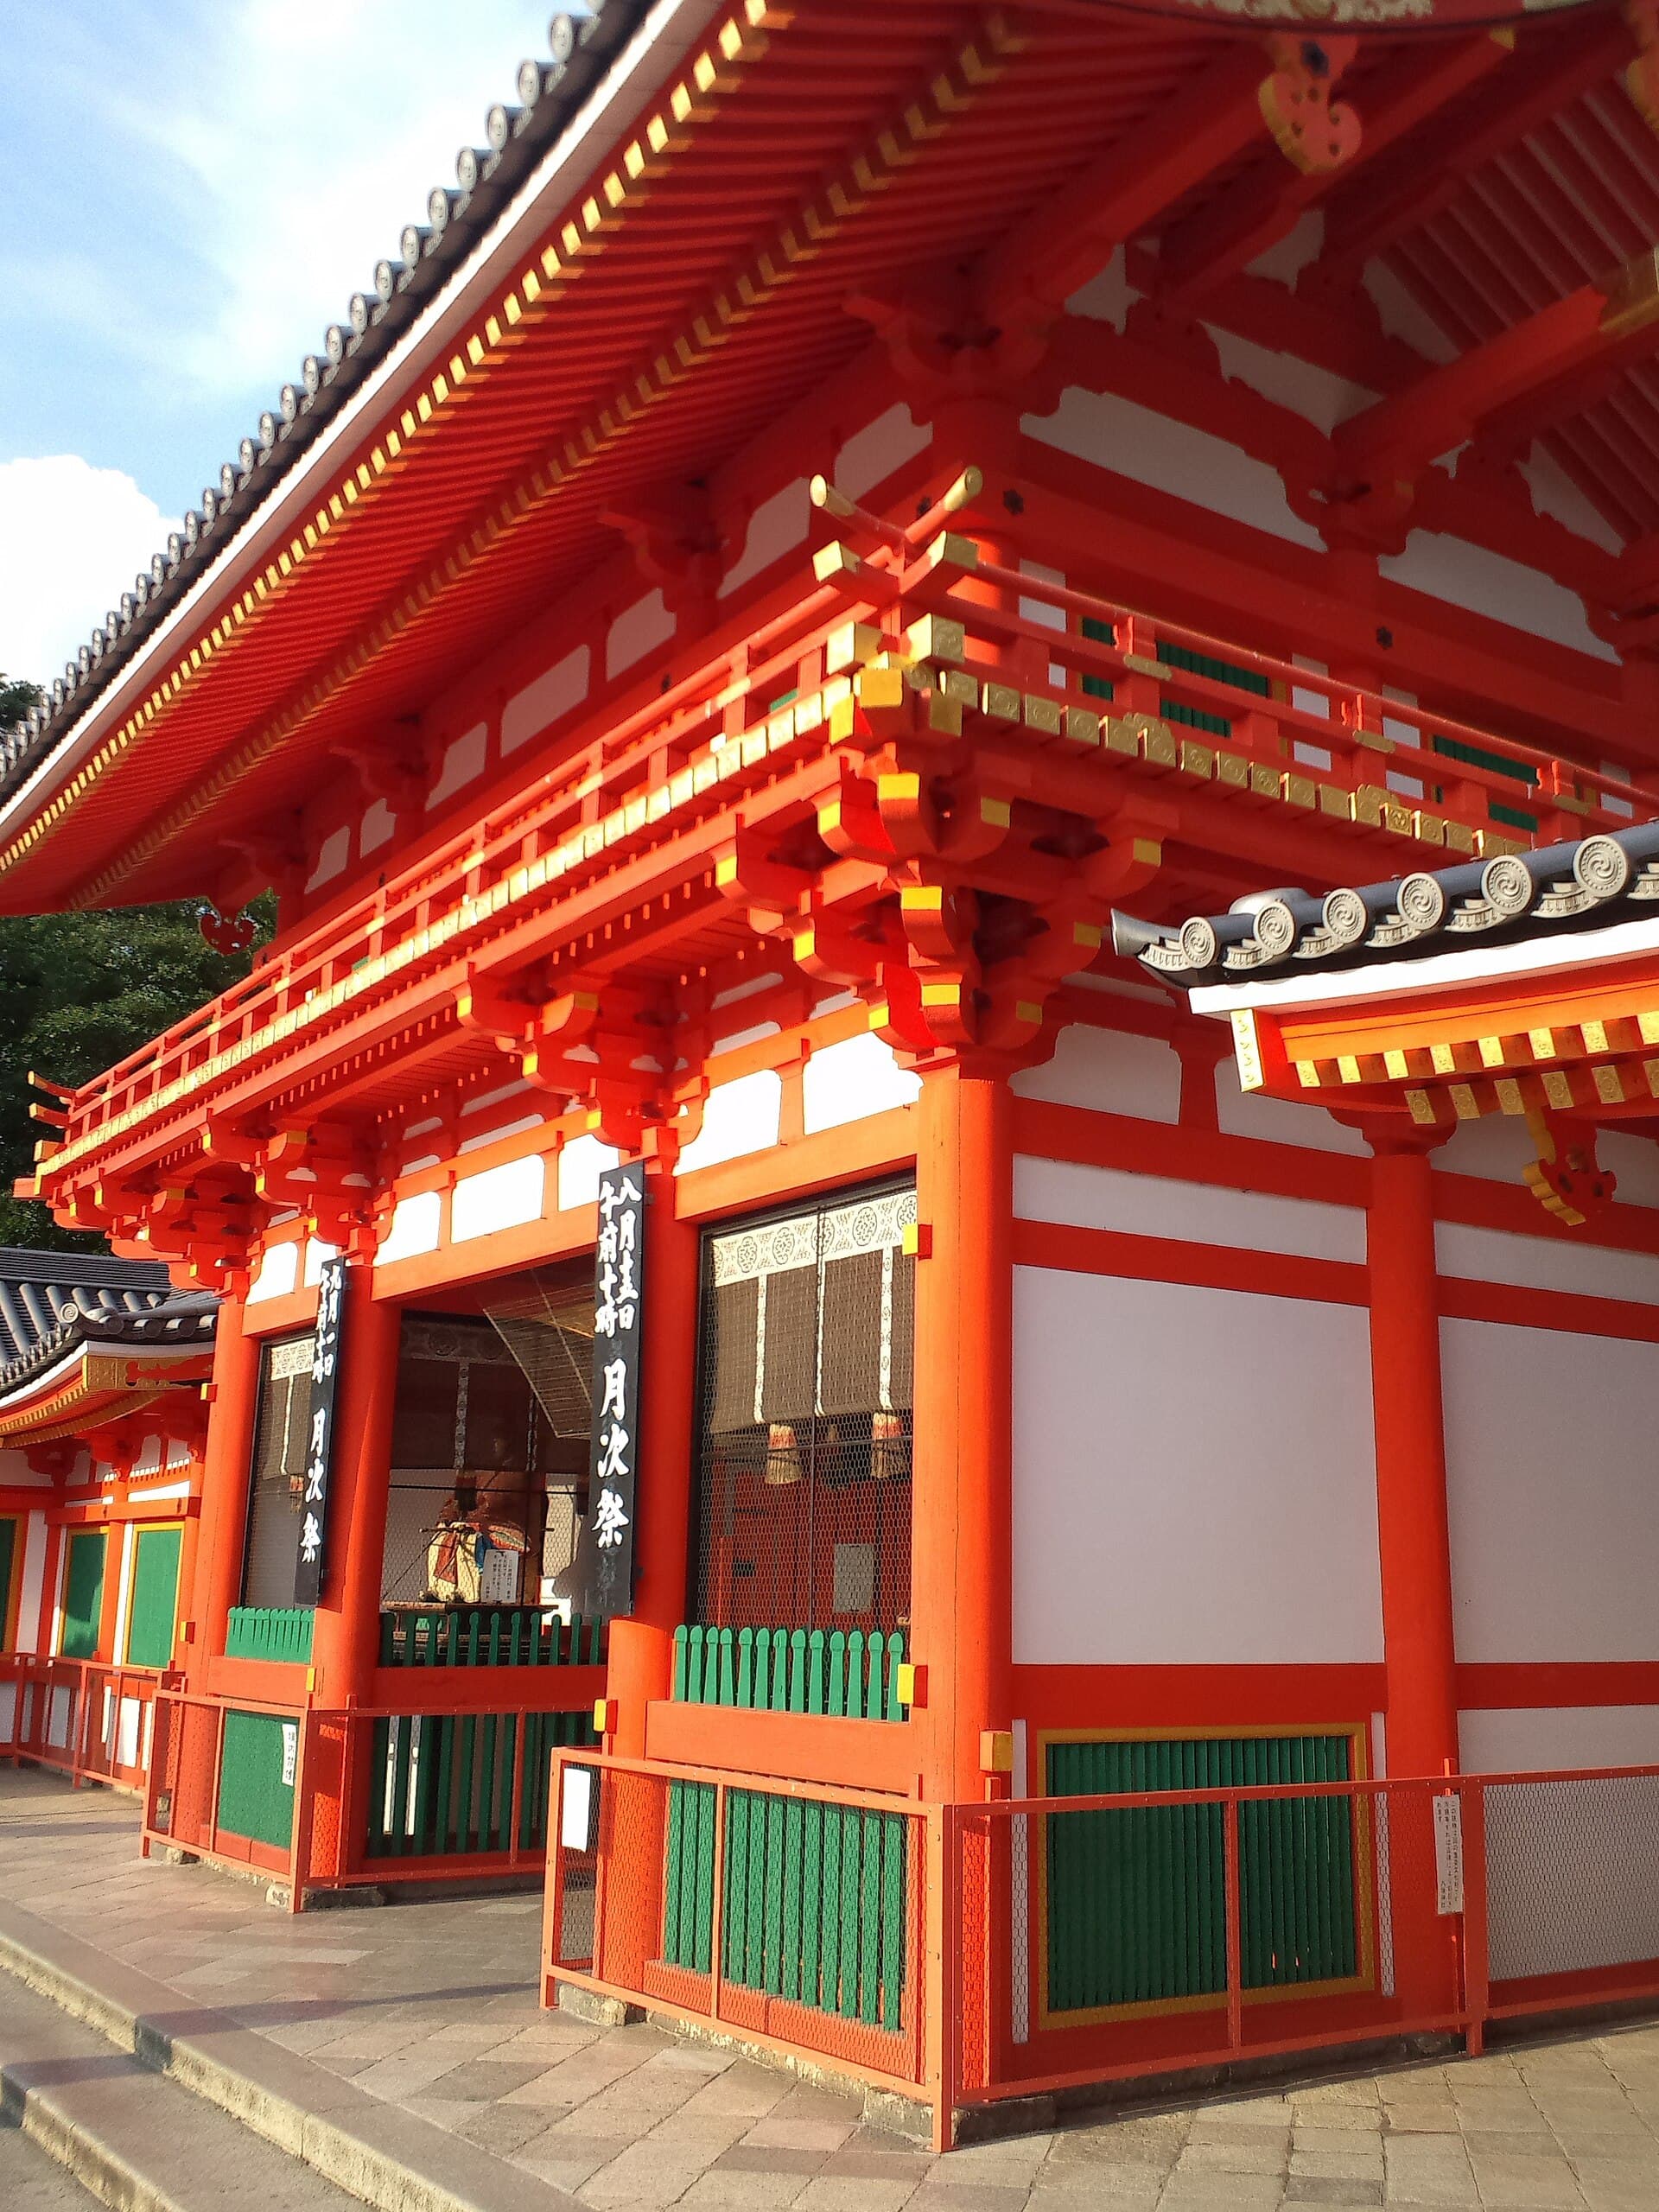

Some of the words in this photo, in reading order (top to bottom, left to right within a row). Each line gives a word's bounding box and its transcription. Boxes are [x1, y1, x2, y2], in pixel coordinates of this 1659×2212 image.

[594, 1180, 619, 1337] 午前十時
[614, 1176, 642, 1330] 八月十五日
[299, 1407, 326, 1563] 月次祭
[592, 1357, 630, 1548] 月次祭
